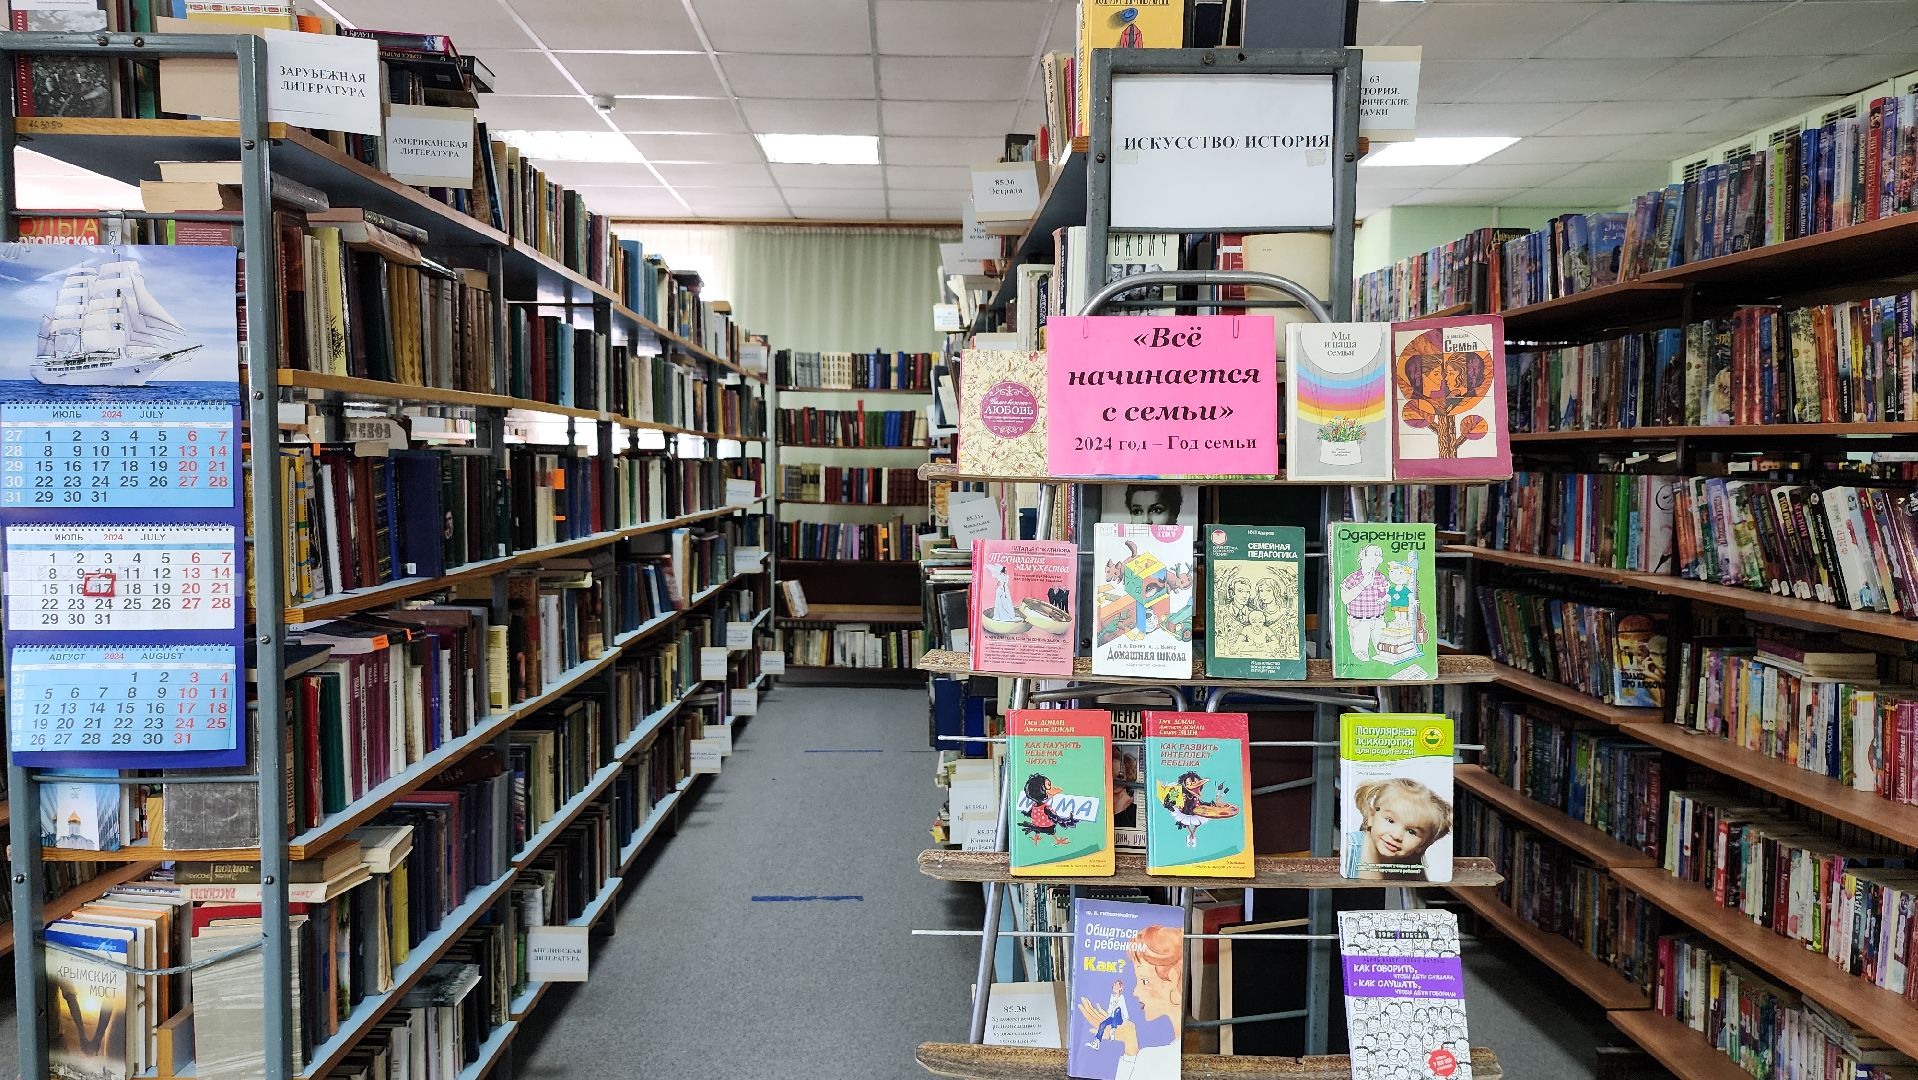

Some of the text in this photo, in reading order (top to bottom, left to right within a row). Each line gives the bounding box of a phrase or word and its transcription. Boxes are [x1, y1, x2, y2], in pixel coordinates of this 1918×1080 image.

[279, 65, 367, 83] ЗАРУБЕЖНАЯ
[1369, 75, 1380, 84] 63
[280, 81, 366, 98] ЛИТЕРАТУРА
[1360, 87, 1400, 95] ТОРИЯ.
[1360, 98, 1409, 106] РИЧЕСКИЕ
[392, 137, 468, 149] АМЕРИКАНСКАЯ
[1124, 135, 1330, 150] ИСКУССТВО/ ИСТОРИЯ
[400, 148, 460, 158] ЛИТЕРАТУРА
[1113, 233, 1167, 257] СКВИЧ
[1133, 326, 1202, 348] «Всё
[1331, 331, 1351, 341] Мы
[1444, 340, 1478, 352] Семья
[1068, 368, 1261, 386] начинается
[984, 406, 1034, 415] ЛЮБОВЬ
[1102, 406, 1234, 421] с семьи»
[6, 431, 227, 442] 27 1 2 3 4 5 6 7
[1074, 436, 1113, 451] 2024
[1119, 440, 1147, 452] год
[1168, 435, 1199, 452] Год
[1204, 438, 1257, 450] семьи
[6, 446, 227, 457] 28 8 9 10 11 12 13 14
[6, 461, 225, 471] 29 15 16 17 18 19 20 21
[6, 476, 227, 487] 30 22 23 24 25 26 27 28
[6, 491, 107, 502] 31 29 30 31
[1338, 528, 1426, 543] Одаренные
[1248, 542, 1291, 550] СЕМЕЙНАЯ
[1391, 541, 1426, 554] дети
[51, 552, 231, 564] 1 2 3 4 5 6 7
[988, 552, 1046, 565] Технология
[1248, 550, 1299, 559] ПЕДАГОГИКА
[1014, 564, 1070, 574] замужества
[1107, 646, 1187, 662] Домашняя школа
[132, 672, 228, 682] 1 2 3 4
[1355, 726, 1417, 738] Популярная
[1355, 738, 1415, 747] психология
[1371, 748, 1415, 756] родителей
[1019, 795, 1093, 818] ММА
[190, 887, 236, 900] РАССКАЗЫ
[1085, 923, 1138, 940] Общаться
[1084, 938, 1147, 952] с ребенком
[1084, 956, 1126, 973] Как?
[1354, 964, 1418, 974] КАК ГОВОРИТЬ,
[57, 966, 118, 984] КРЫМСКИЙ
[1358, 979, 1422, 989] КАК СЛУШАТЬ,
[90, 984, 117, 998] МОСТ
[1003, 1005, 1027, 1013] 85.38
